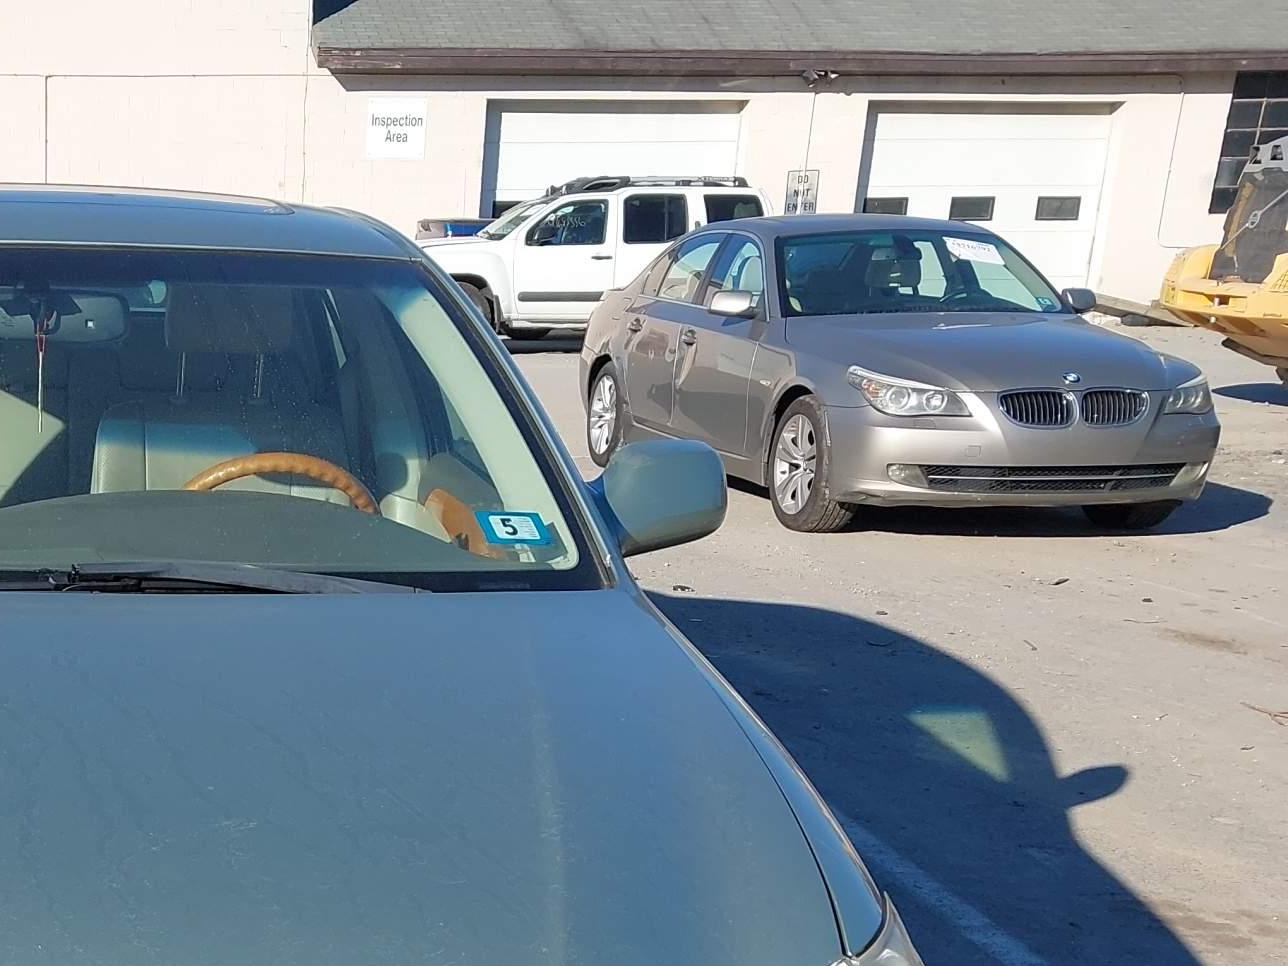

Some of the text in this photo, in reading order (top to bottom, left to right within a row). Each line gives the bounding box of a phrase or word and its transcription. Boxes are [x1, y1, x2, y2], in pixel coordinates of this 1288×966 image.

[371, 113, 423, 129] Inspection
[384, 129, 408, 143] Area
[797, 174, 809, 184] DO
[499, 517, 519, 536] 5
